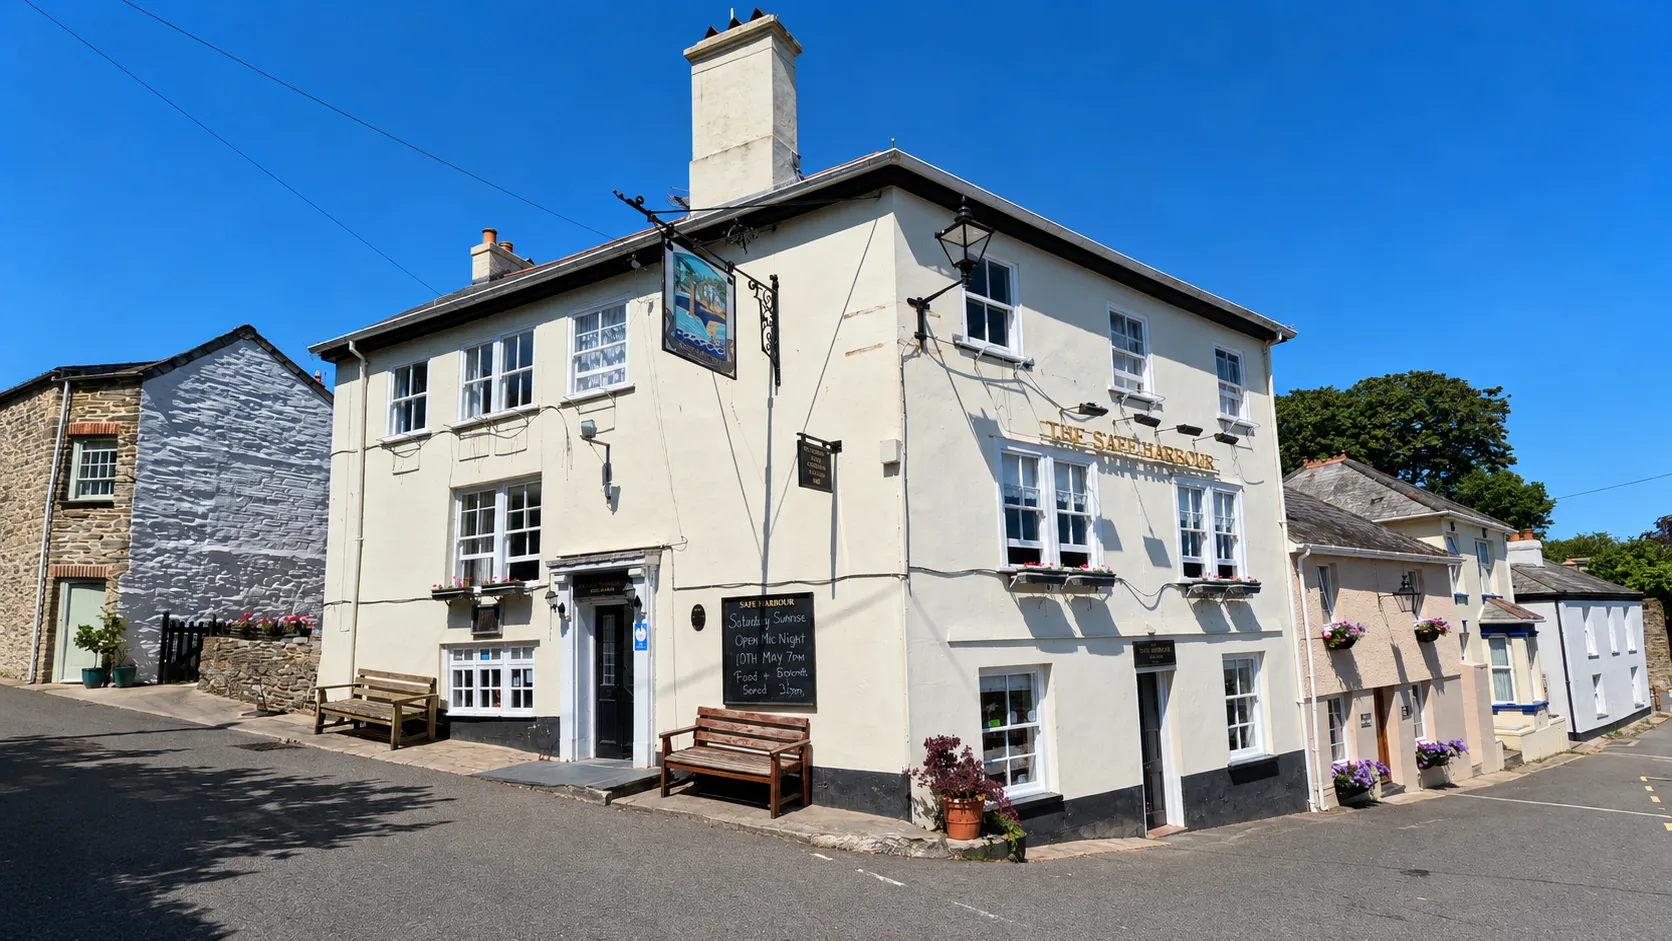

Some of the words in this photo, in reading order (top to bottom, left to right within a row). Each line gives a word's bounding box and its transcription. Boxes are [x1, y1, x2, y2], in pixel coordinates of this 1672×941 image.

[1041, 421, 1091, 445] THE
[1092, 431, 1140, 452] SAFE
[1142, 442, 1214, 469] HARBOUR
[739, 600, 757, 609] SAFE
[758, 598, 795, 607] HARBOUR
[773, 611, 807, 624] Sunrise
[778, 632, 807, 648] Night
[736, 652, 757, 667] 10TH
[762, 651, 783, 665] May
[733, 670, 757, 684] Food
